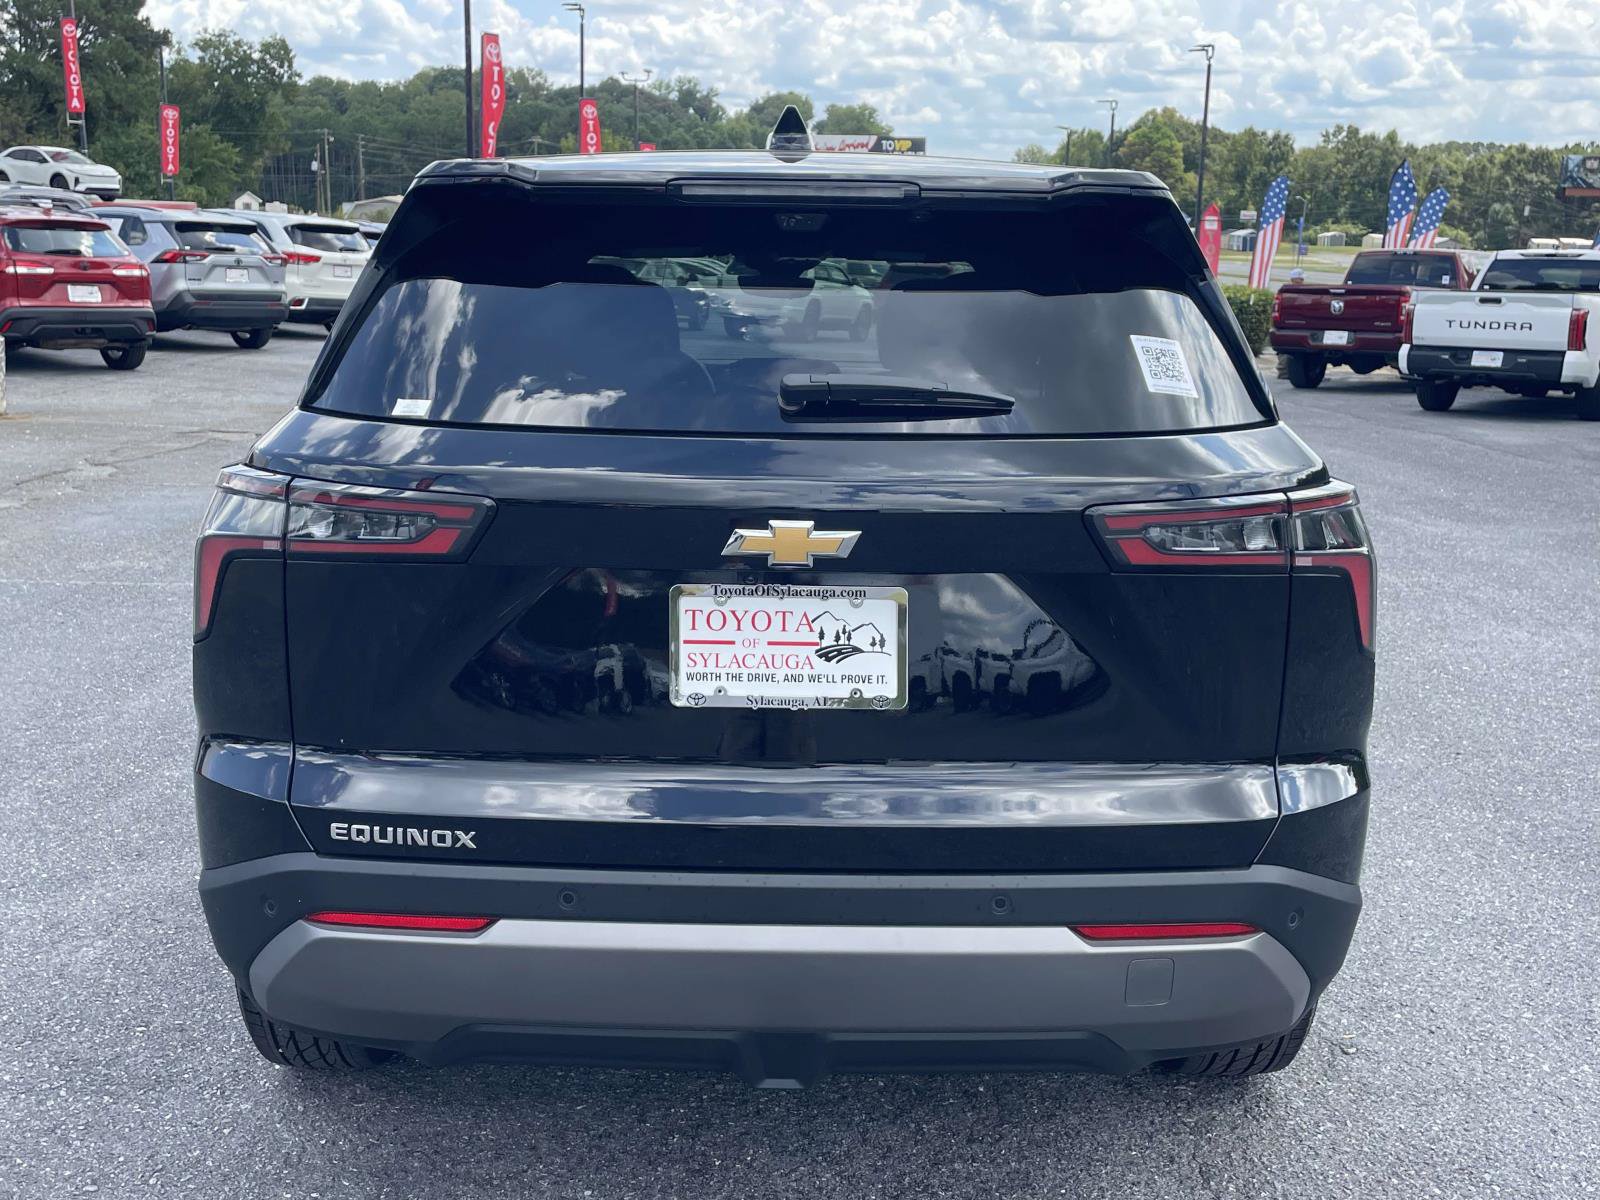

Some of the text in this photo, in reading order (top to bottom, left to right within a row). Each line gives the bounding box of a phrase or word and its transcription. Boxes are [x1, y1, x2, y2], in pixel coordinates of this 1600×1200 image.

[166, 119, 175, 172] TOYOTA
[1446, 319, 1533, 332] TUNDRA
[711, 584, 867, 600] ToyotaOfSylacauga.com
[685, 609, 815, 632] TOYOTA
[742, 638, 760, 649] OF
[687, 652, 815, 670] SYLACAUGA
[686, 672, 888, 685] WORTH THE DRIVE, AND WE'LL PROVE IT.
[746, 695, 809, 708] Sylacauga,
[330, 822, 477, 849] EQUINOX
